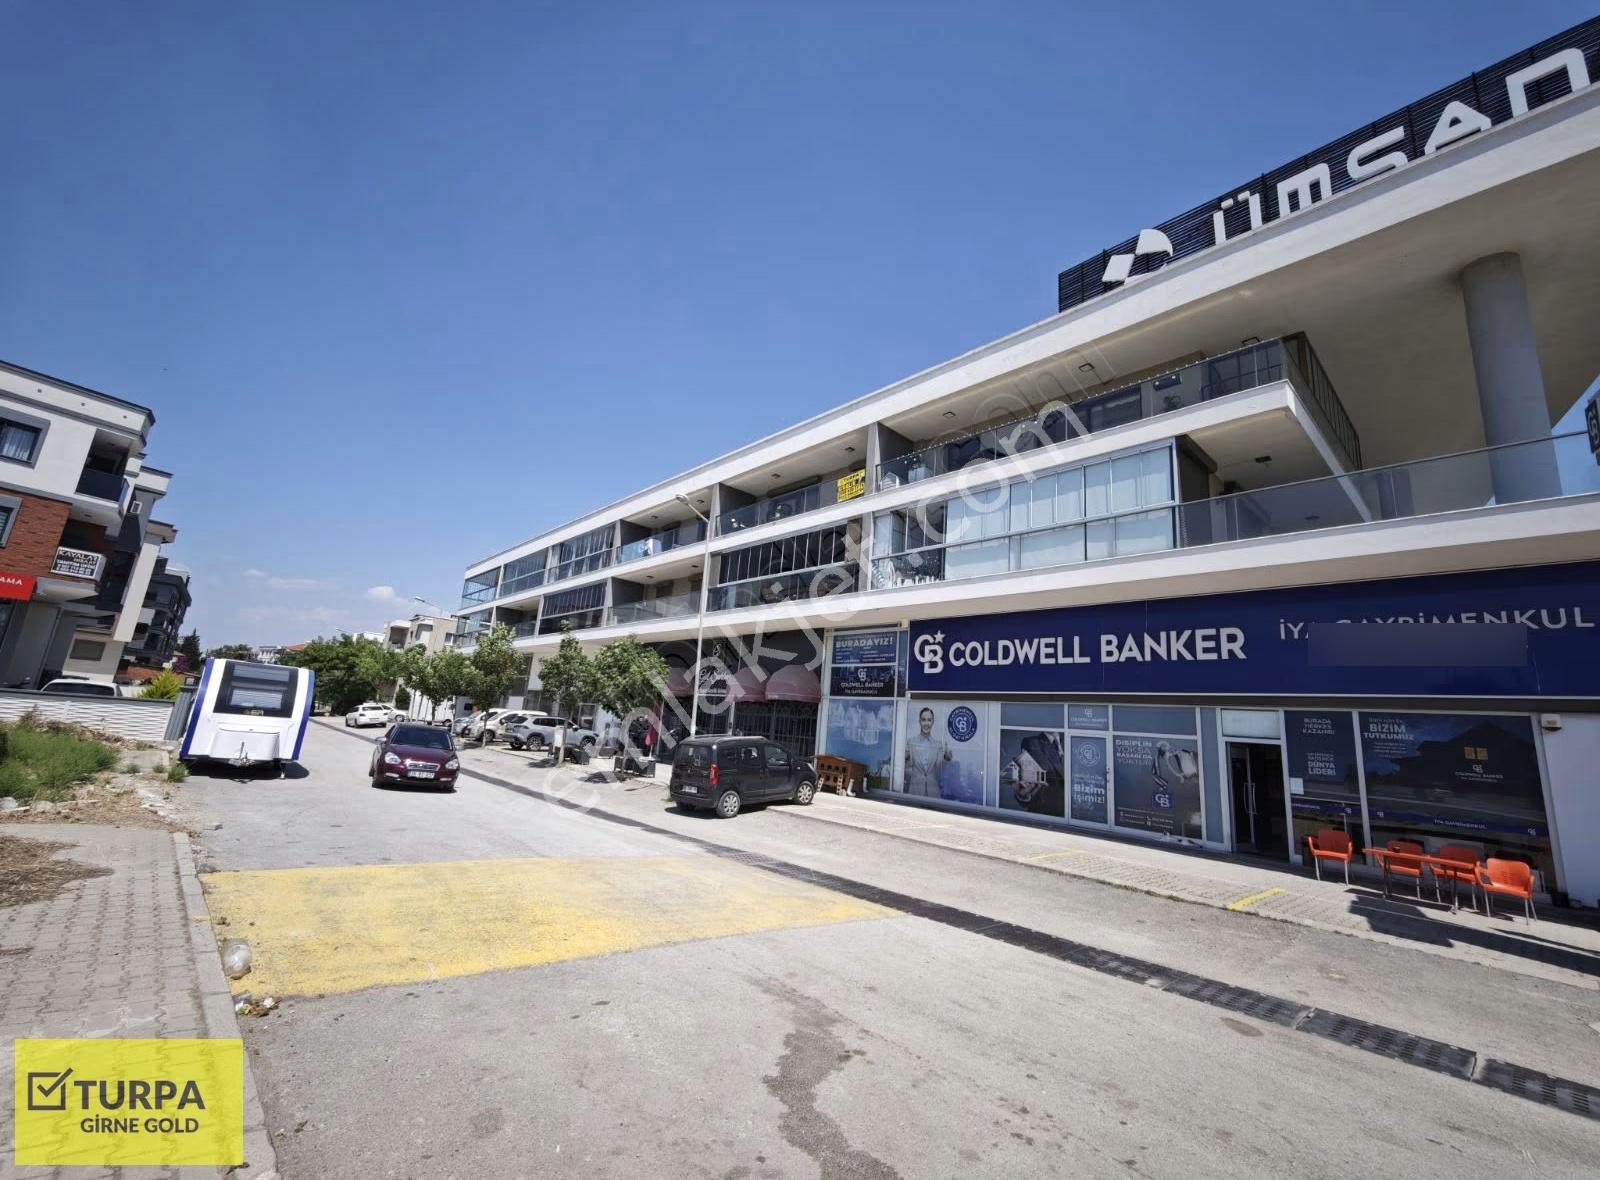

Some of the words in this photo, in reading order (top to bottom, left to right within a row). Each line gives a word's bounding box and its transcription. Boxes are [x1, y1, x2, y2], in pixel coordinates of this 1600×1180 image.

[1280, 618, 1308, 640] İY
[835, 637, 893, 648] BURADAYIZ!
[949, 635, 1091, 667] COLDWELL
[1100, 627, 1247, 663] BANKER
